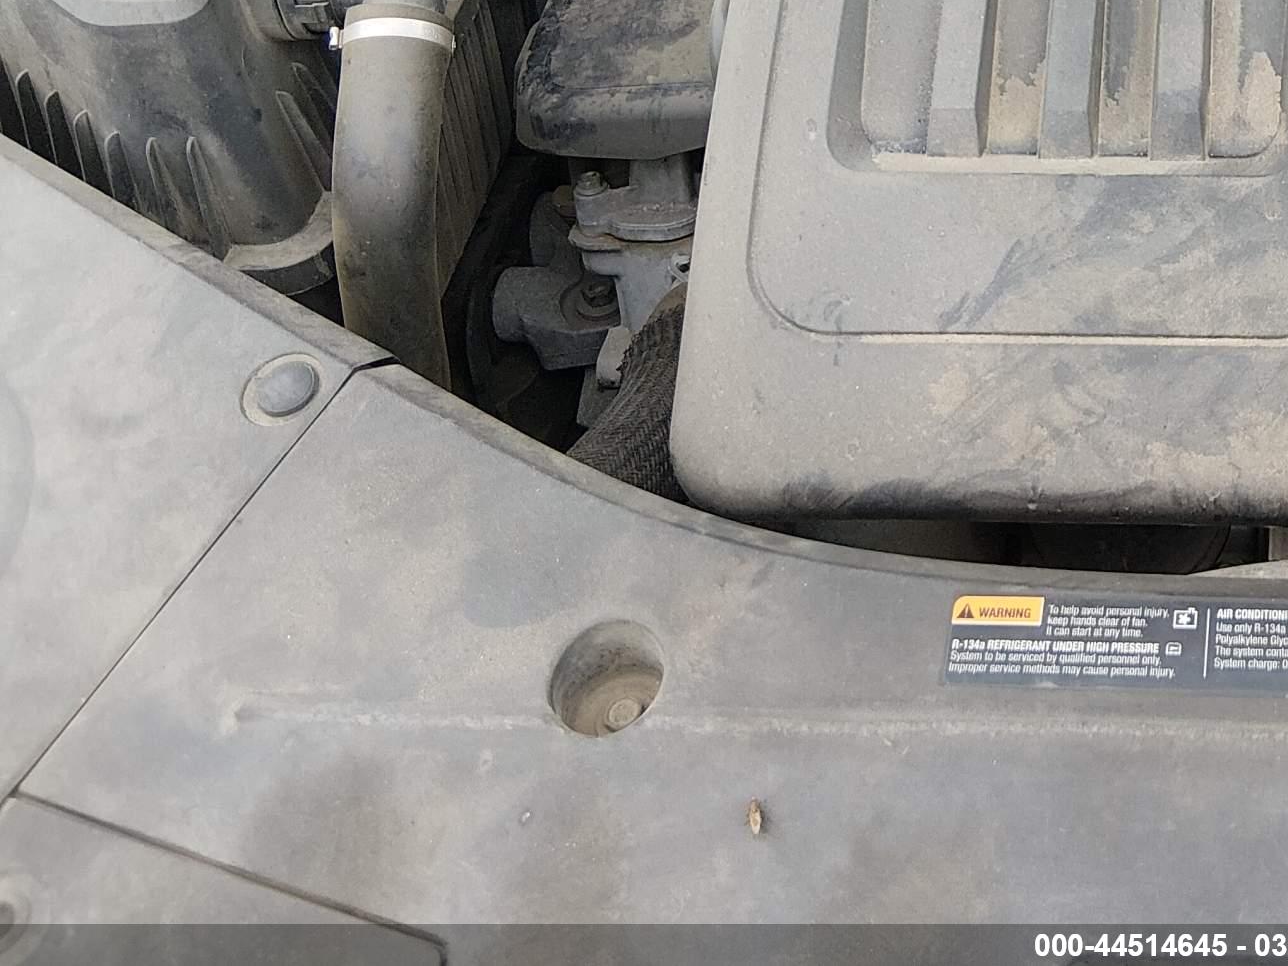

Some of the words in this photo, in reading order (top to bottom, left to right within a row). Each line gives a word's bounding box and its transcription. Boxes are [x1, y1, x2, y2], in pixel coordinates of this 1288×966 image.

[979, 607, 1031, 618] WARNING
[1048, 605, 1058, 614] To
[1061, 605, 1079, 614] help
[1081, 605, 1104, 615] avoid
[1106, 606, 1142, 617] personal
[1216, 608, 1233, 619] AIR
[1047, 616, 1068, 625] keep
[1071, 617, 1096, 625] hands
[1098, 617, 1119, 626] clear
[1122, 618, 1130, 626] of
[1132, 618, 1148, 627] fan.
[1054, 627, 1070, 635] can
[1072, 628, 1091, 636] start
[1093, 628, 1102, 636] at
[1104, 629, 1120, 639] any
[1122, 629, 1143, 638] time.
[1216, 622, 1232, 632] Use
[1234, 622, 1252, 634] only
[1254, 623, 1286, 634] R-134a
[1215, 634, 1268, 646] Polyalkylene
[951, 639, 985, 650] R-134a
[987, 640, 1052, 651] REFRIGERANT
[1053, 641, 1084, 651] UNDER
[1086, 642, 1109, 652] HIGH
[1111, 643, 1160, 654] PRESSURE
[1215, 646, 1232, 656] The
[1232, 647, 1264, 658] system
[950, 651, 982, 662] System
[985, 651, 993, 661] to
[995, 652, 1006, 661] be
[1008, 652, 1044, 662] serviced
[1046, 653, 1057, 663] by
[1059, 653, 1095, 663] qualified
[1098, 655, 1140, 665] personnel
[949, 662, 987, 674] Improper
[990, 663, 1021, 673] service
[1023, 664, 1060, 674] methods
[1062, 665, 1081, 677] may
[1083, 666, 1109, 675] cause
[1110, 667, 1147, 678] personal
[1214, 658, 1246, 670] System
[1248, 659, 1280, 671] charge:
